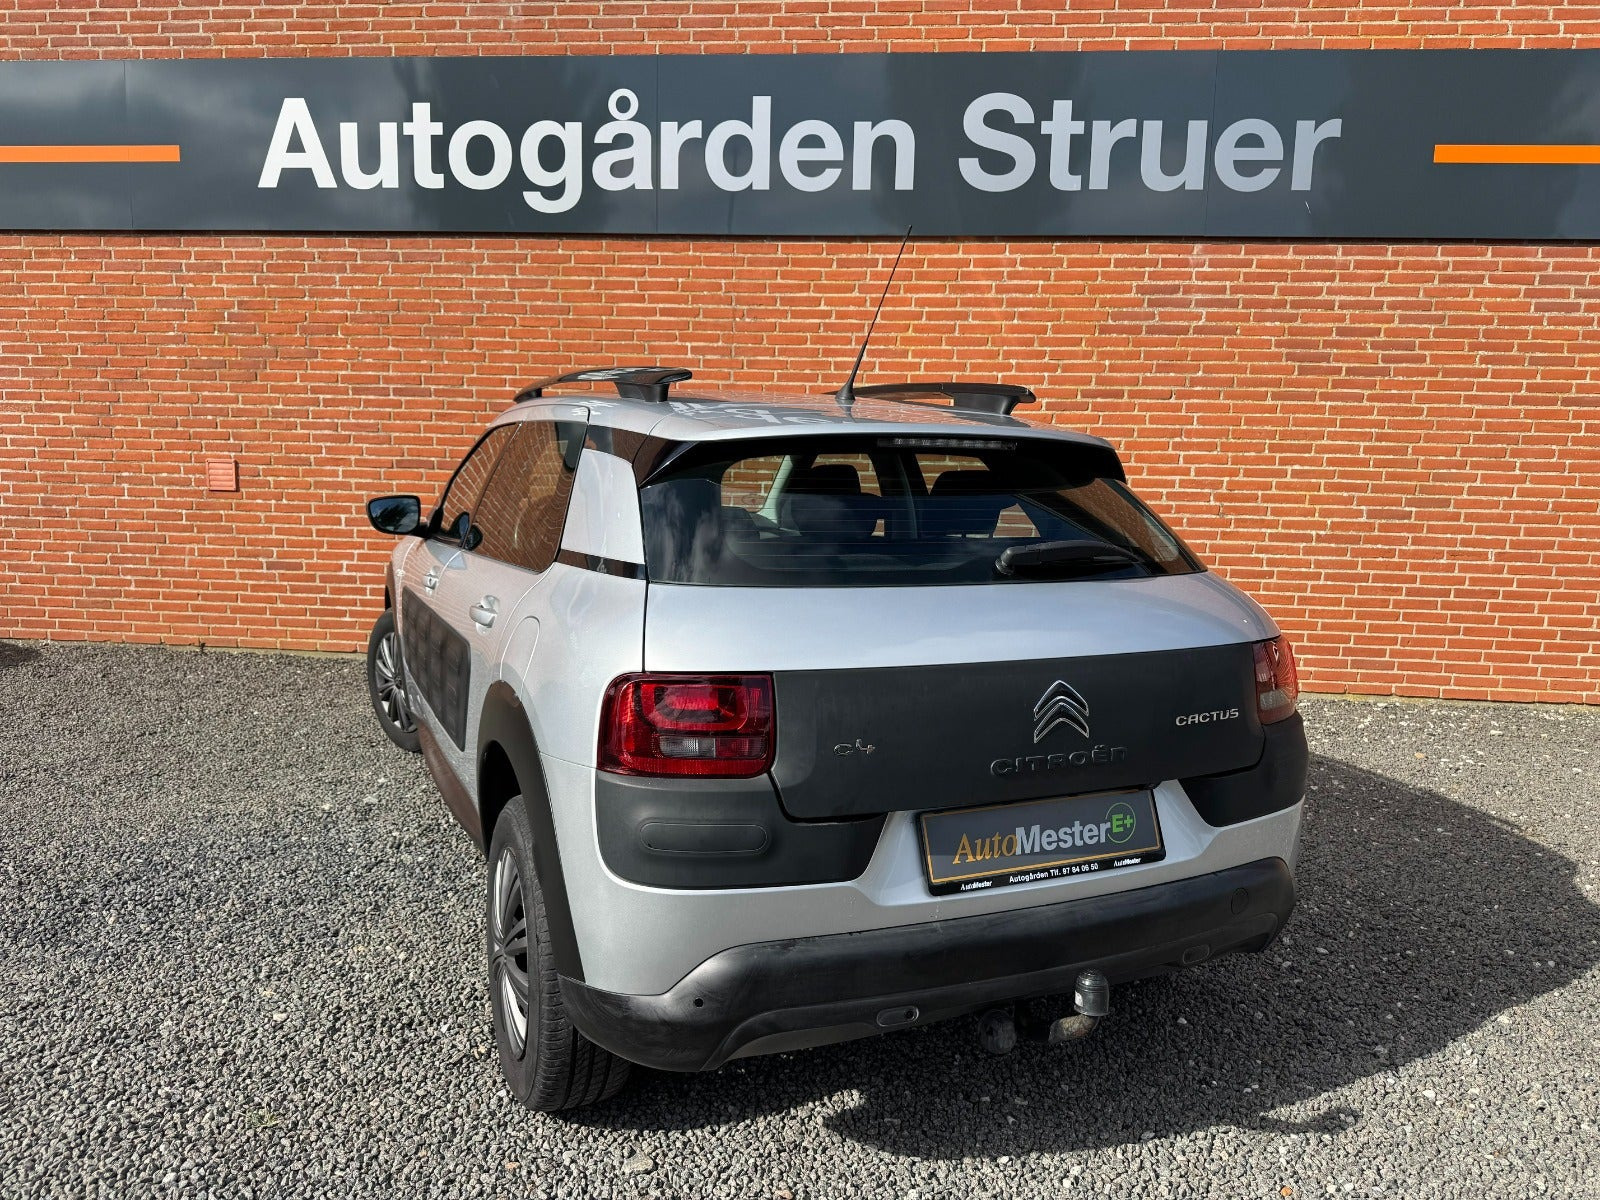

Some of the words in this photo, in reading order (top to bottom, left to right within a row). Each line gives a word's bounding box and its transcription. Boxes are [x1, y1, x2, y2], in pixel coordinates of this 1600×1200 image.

[258, 88, 915, 213] Autogården
[958, 92, 1342, 193] Struer
[1175, 708, 1240, 726] CACTUS
[833, 738, 876, 757] C4
[952, 820, 1111, 864] AutoMester
[1009, 871, 1049, 883] Autogården
[1062, 867, 1070, 875] 97
[1071, 865, 1080, 873] 84
[1081, 864, 1089, 872] 06
[1090, 862, 1099, 870] 50
